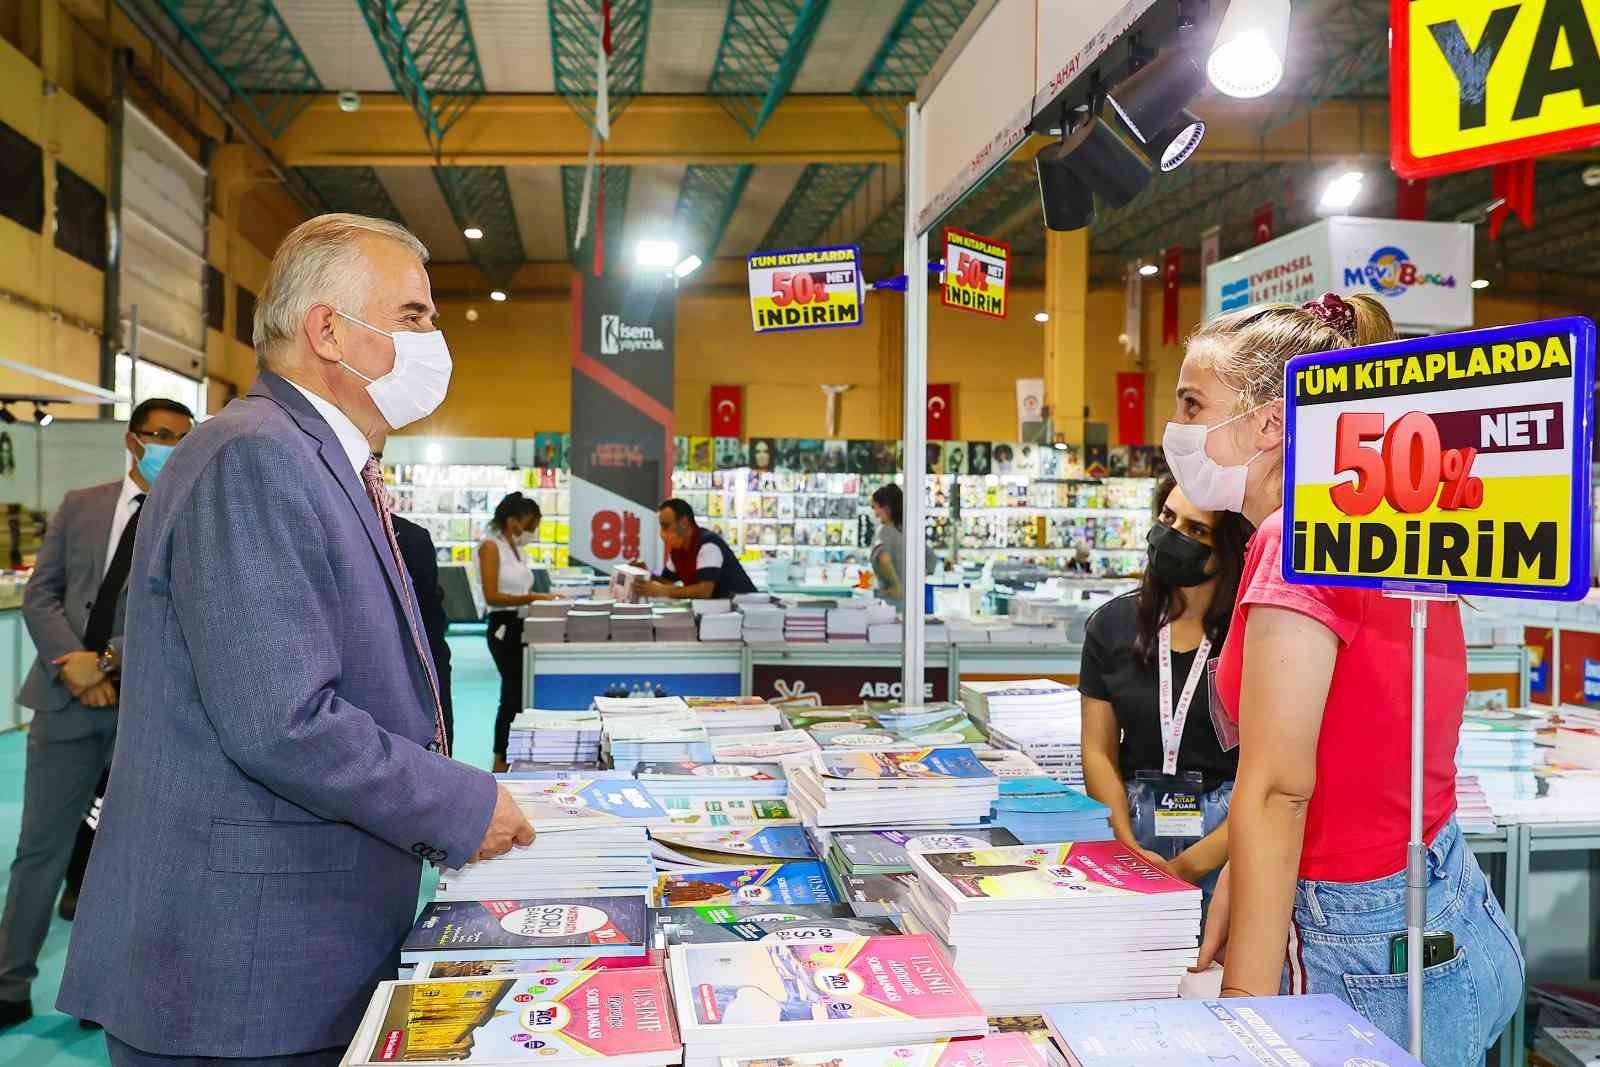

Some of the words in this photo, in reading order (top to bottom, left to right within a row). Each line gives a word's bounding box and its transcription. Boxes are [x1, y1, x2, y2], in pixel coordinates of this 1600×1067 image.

[1250, 255, 1313, 286] EVRENSEL
[1481, 409, 1555, 448] NET
[859, 682, 934, 698] ABOE
[538, 907, 563, 934] SORU
[536, 1009, 553, 1026] ACI
